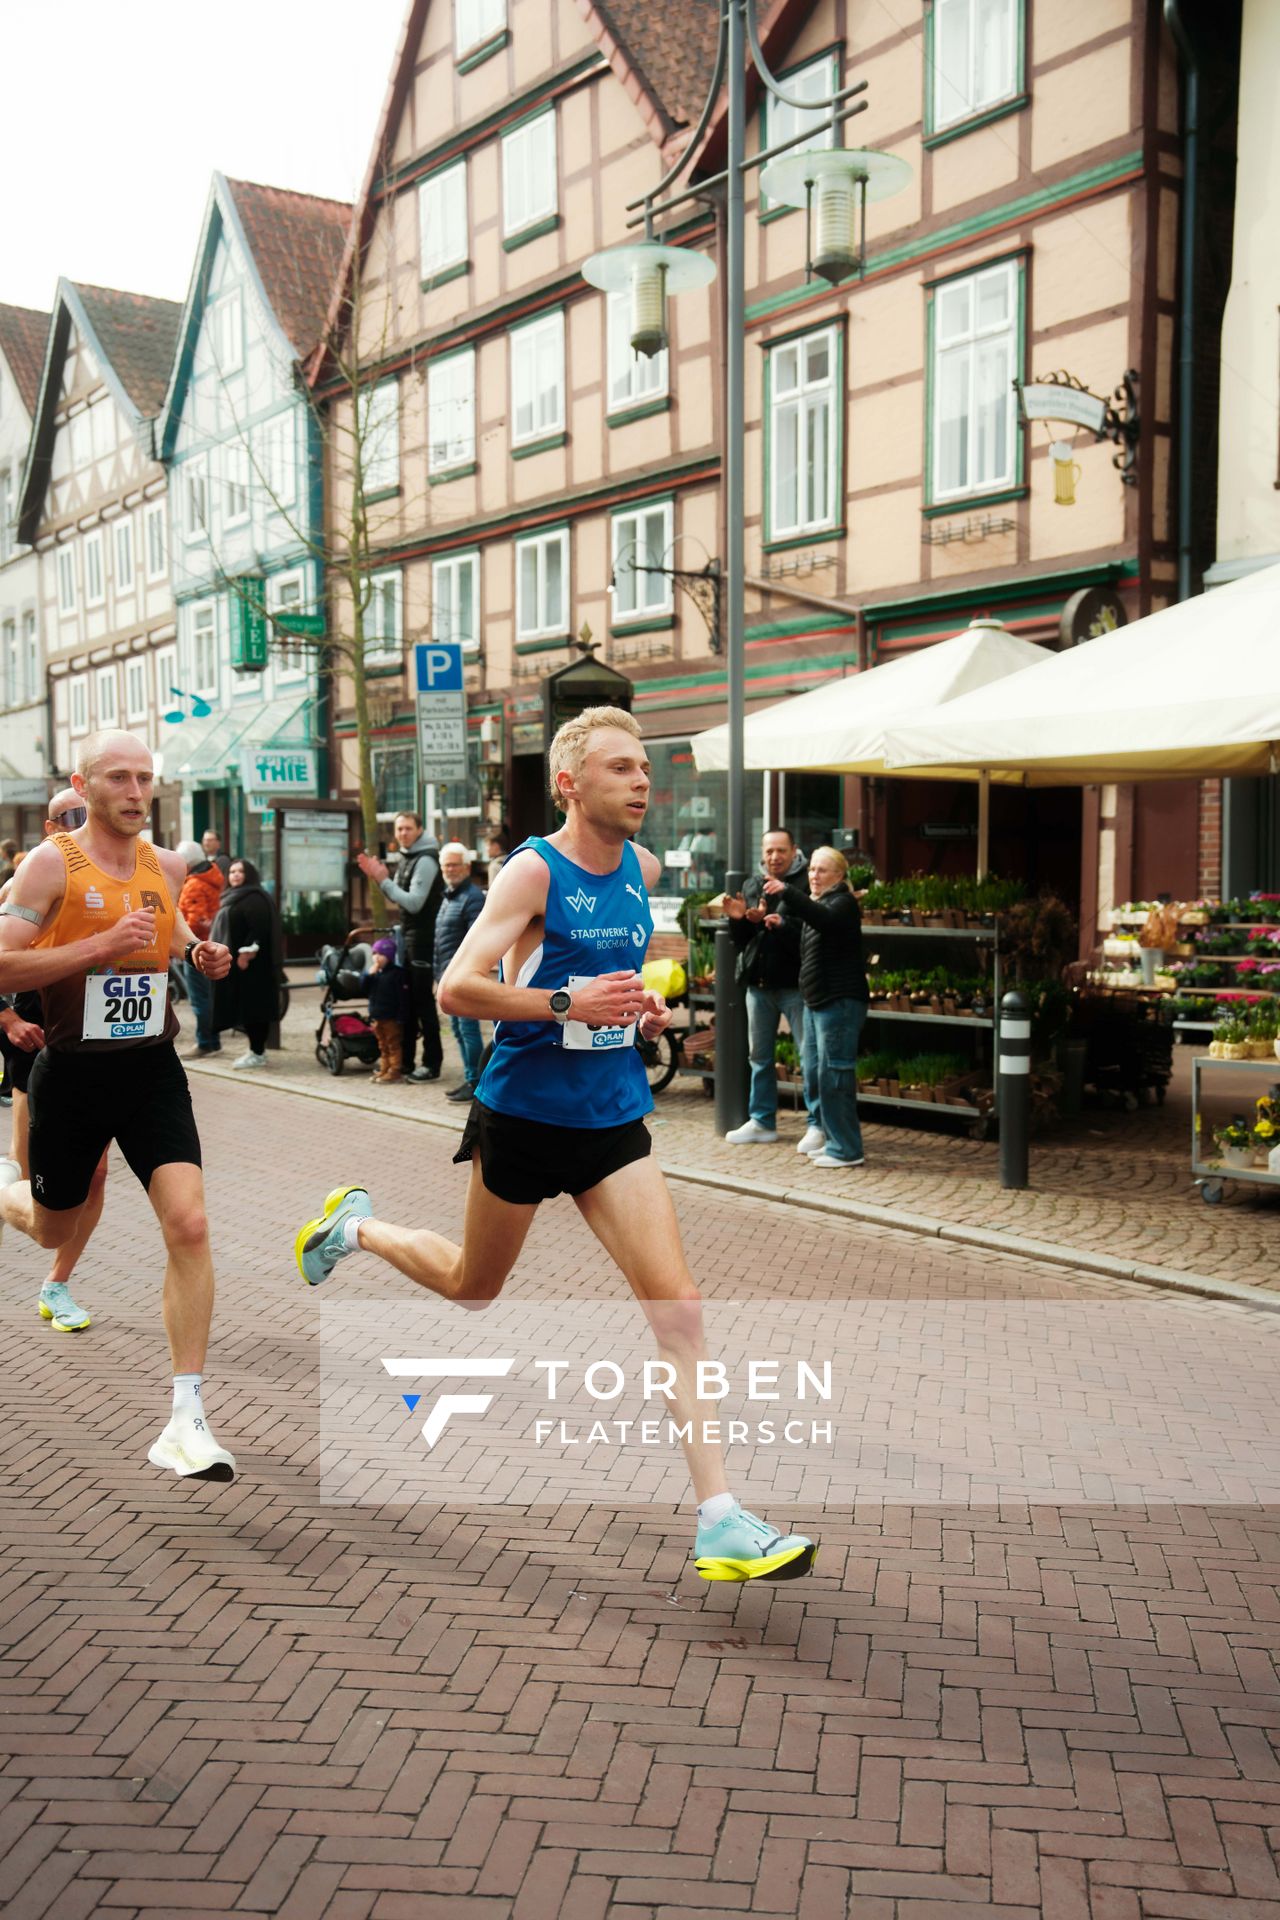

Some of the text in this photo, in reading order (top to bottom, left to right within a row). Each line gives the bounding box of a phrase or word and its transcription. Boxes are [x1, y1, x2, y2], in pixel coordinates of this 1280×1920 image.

[426, 650, 452, 686] P
[421, 706, 461, 714] Parkschein
[256, 764, 308, 781] THIE
[570, 927, 629, 939] STADTWERKE
[596, 939, 629, 950] BOCHUM
[104, 997, 152, 1022] 200
